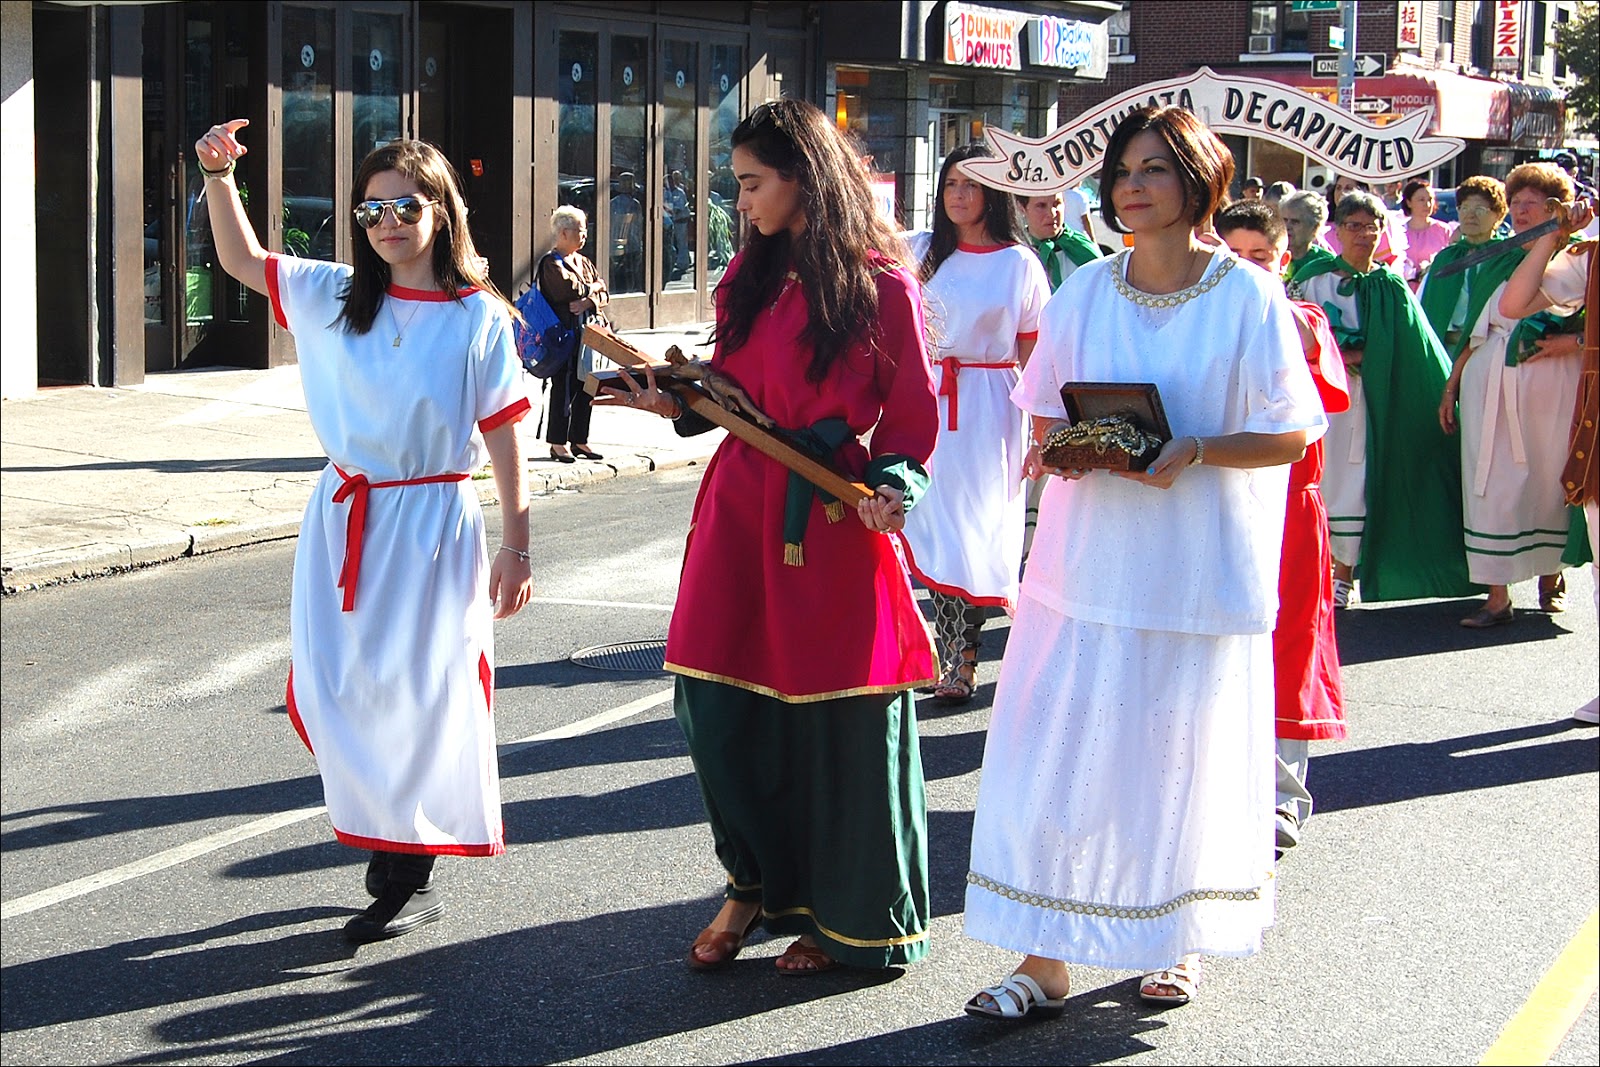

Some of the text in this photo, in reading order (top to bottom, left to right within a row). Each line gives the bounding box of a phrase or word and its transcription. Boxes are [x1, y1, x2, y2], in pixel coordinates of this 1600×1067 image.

[967, 14, 1014, 40] DUNKIN'
[1400, 1, 1417, 44] 拉麵
[1497, 1, 1518, 56] PIZZA
[966, 40, 1012, 66] DONUTS
[1319, 61, 1338, 71] ONE
[1007, 150, 1049, 182] Sta.
[1223, 87, 1414, 171] DECAPITATED
